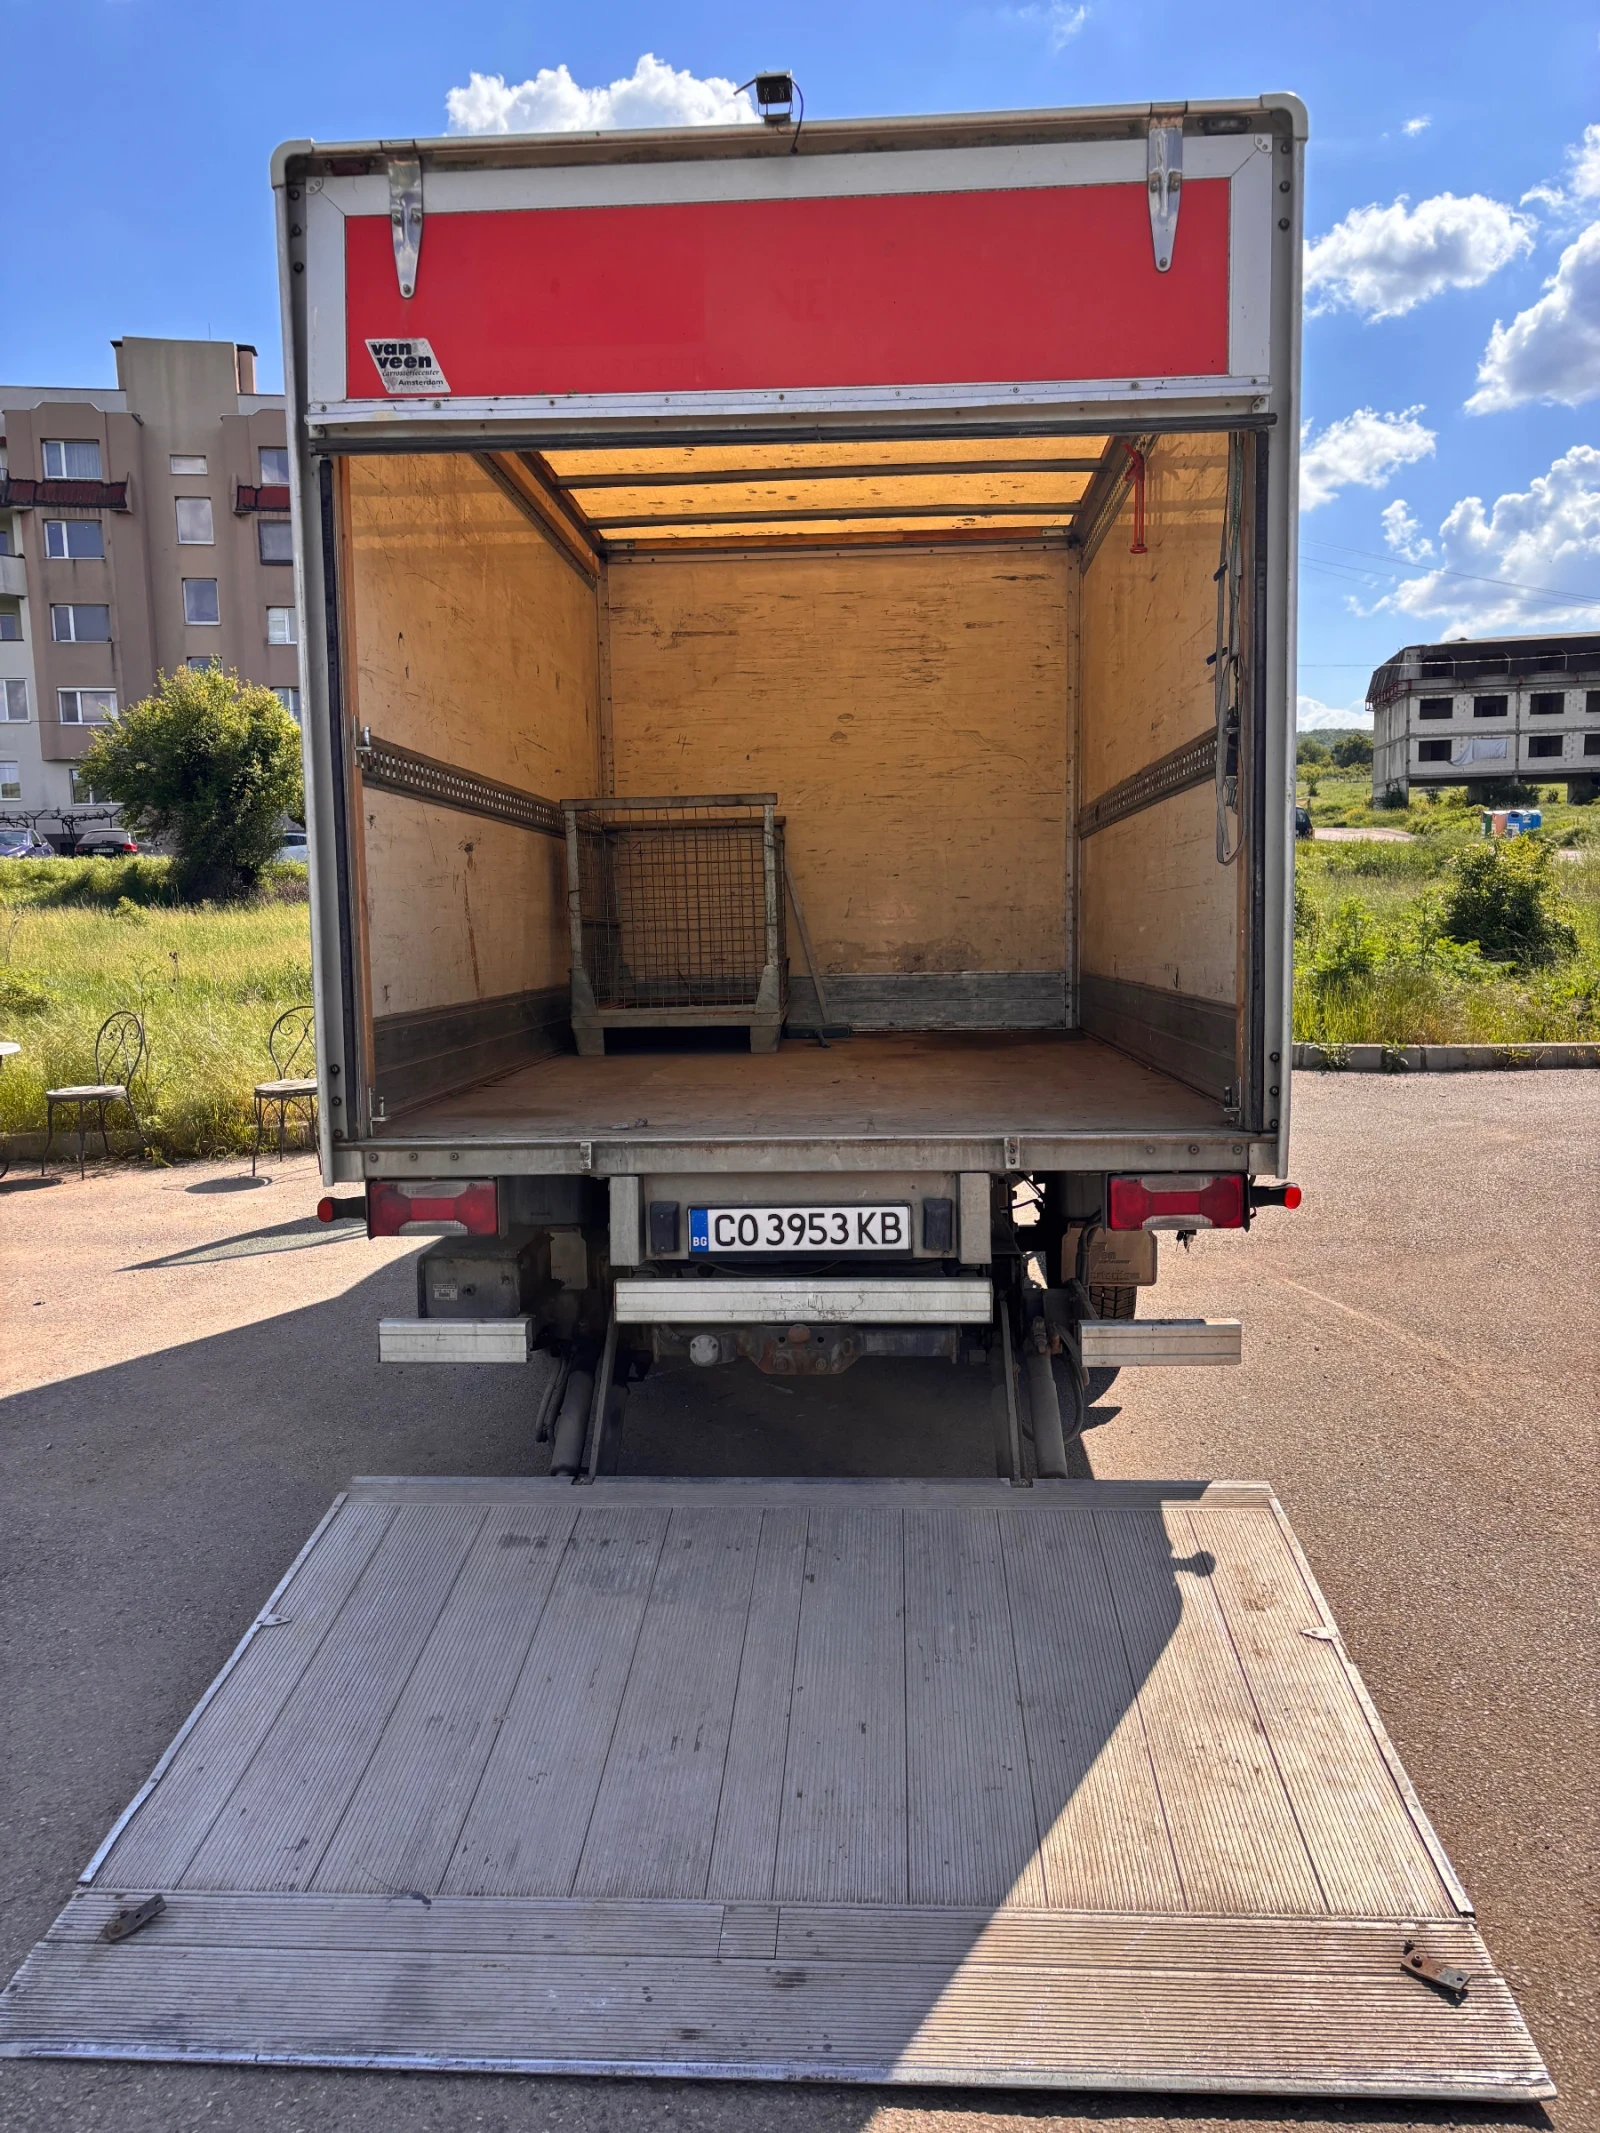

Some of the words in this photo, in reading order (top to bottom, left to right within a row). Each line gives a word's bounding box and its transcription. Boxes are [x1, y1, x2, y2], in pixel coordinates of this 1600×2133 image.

[371, 343, 412, 355] van
[377, 356, 432, 369] veen
[692, 1236, 708, 1247] BG
